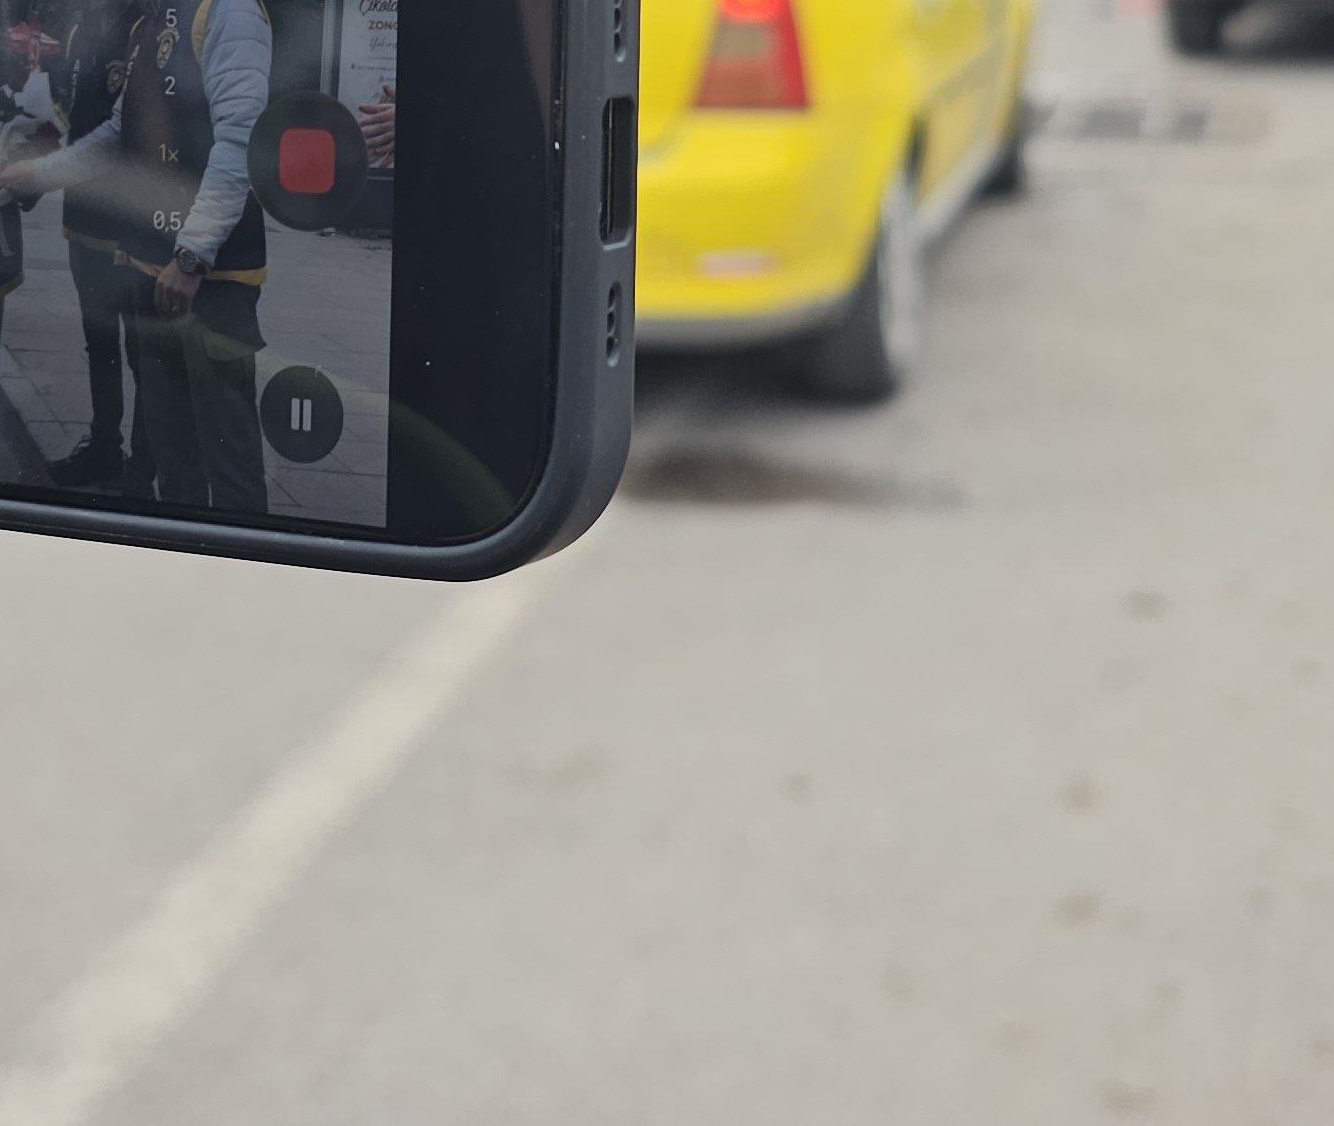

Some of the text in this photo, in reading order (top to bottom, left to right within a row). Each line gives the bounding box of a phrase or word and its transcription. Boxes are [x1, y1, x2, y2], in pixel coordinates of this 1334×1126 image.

[165, 8, 178, 28] 5
[164, 75, 176, 95] 2
[158, 143, 179, 162] 1x
[153, 210, 182, 233] 0,5
